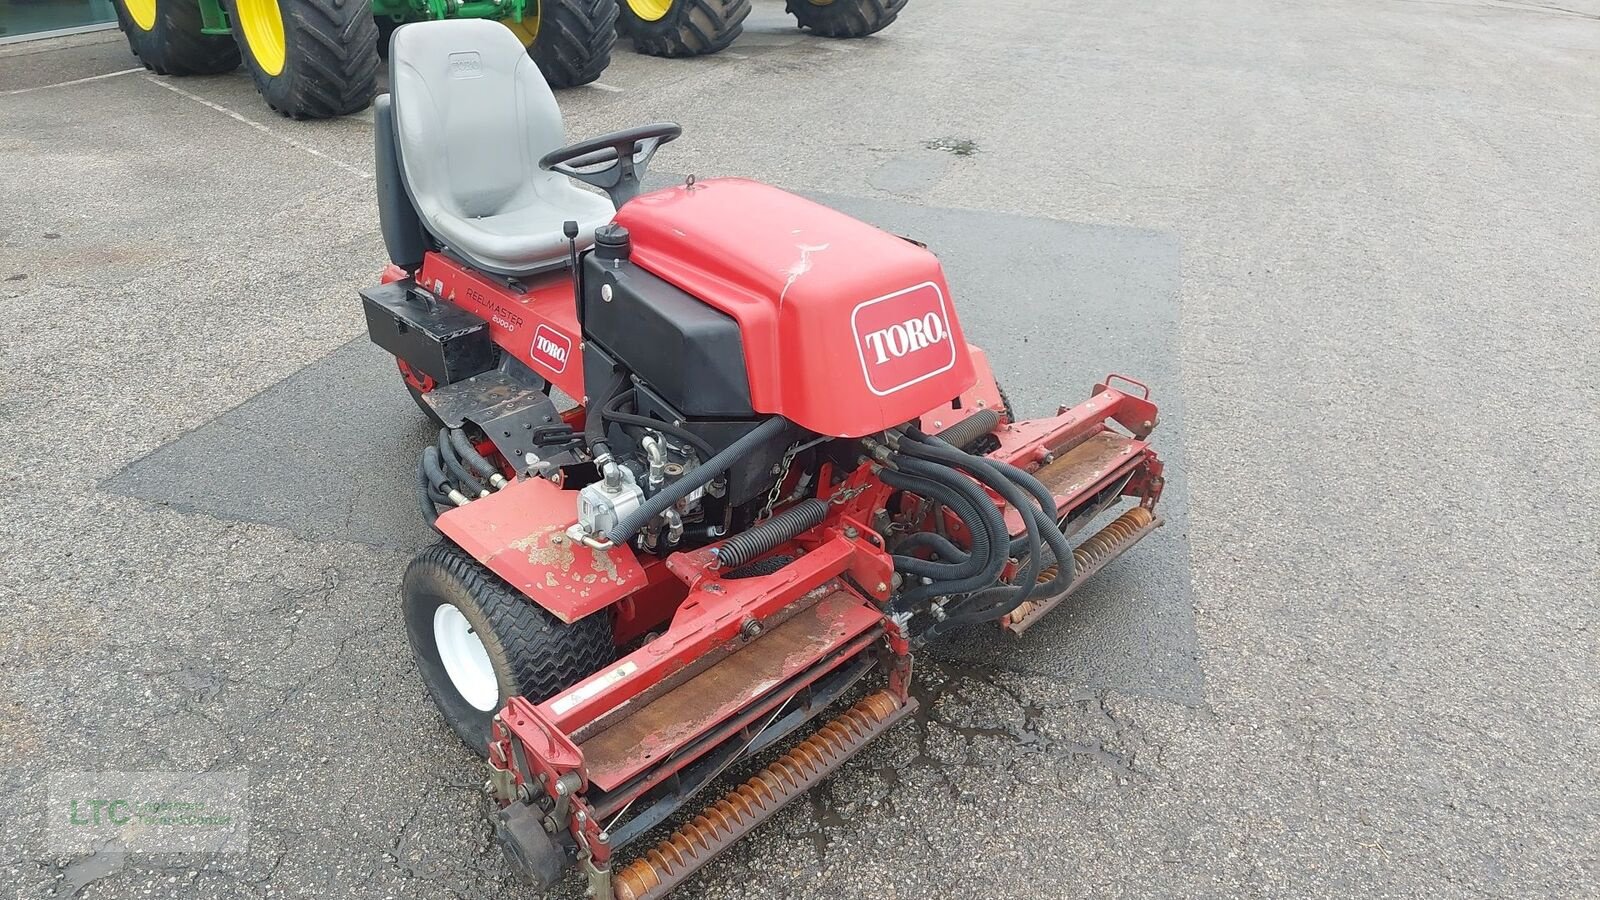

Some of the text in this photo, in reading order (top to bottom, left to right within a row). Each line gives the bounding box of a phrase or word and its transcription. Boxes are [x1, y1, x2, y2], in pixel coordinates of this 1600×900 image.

[466, 287, 524, 328] REELMASTER
[537, 335, 566, 362] TORO
[864, 311, 943, 365] TORO
